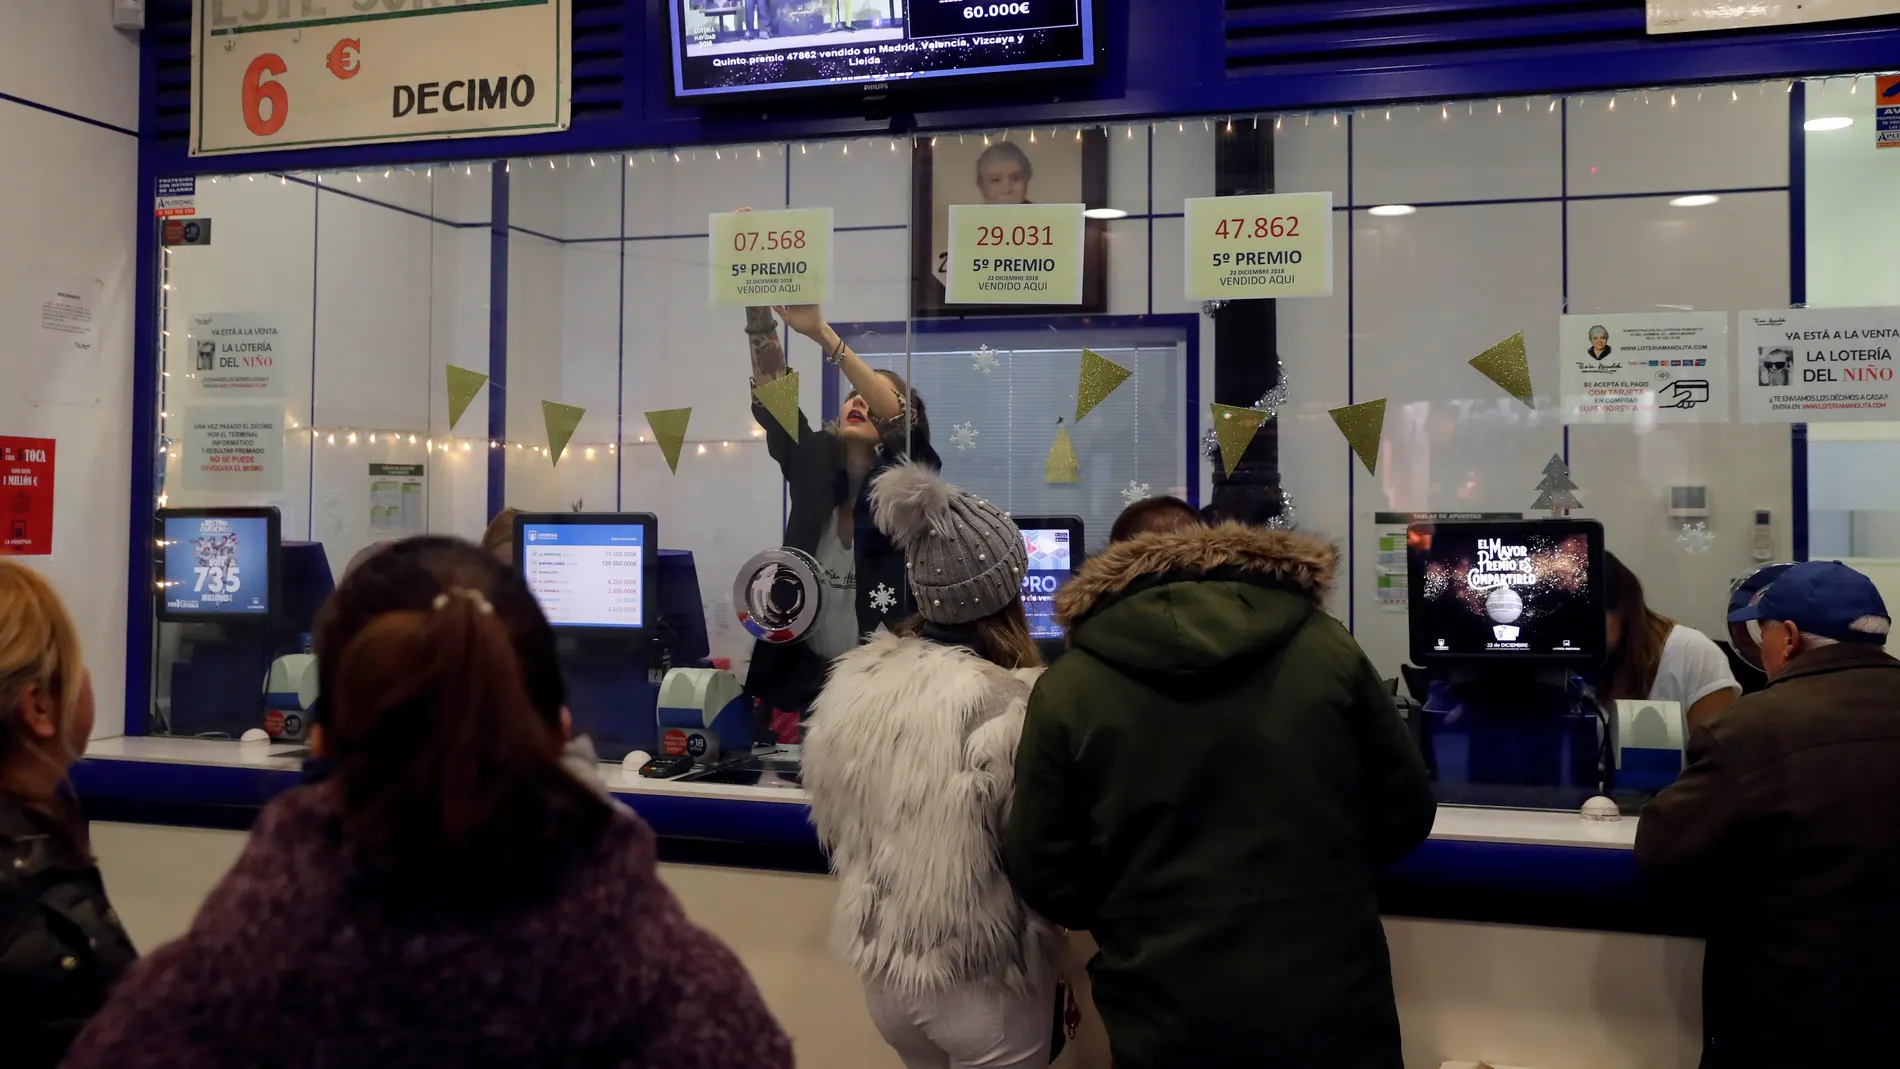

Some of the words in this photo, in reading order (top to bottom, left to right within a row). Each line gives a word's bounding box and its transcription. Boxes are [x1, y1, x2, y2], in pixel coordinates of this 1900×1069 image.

[963, 2, 1030, 19] 60.000€
[713, 58, 747, 67] Quinto
[750, 54, 784, 65] premio
[787, 51, 816, 60] 47862
[819, 48, 860, 58] vendido
[972, 35, 1014, 46] Vizcaya
[1017, 34, 1024, 44] y
[849, 56, 881, 66] Lleida
[242, 53, 288, 136] 6
[326, 38, 360, 80] €
[864, 83, 888, 91] PHILIPS
[393, 74, 535, 118] DECIMO
[1215, 216, 1300, 239] 47.862
[734, 230, 806, 252] 07.568
[976, 225, 1054, 246] 29.031
[972, 259, 989, 272] 5º
[994, 258, 1055, 272] PREMIO
[1212, 253, 1230, 267] 5º
[1236, 250, 1302, 266] PREMIO
[732, 264, 747, 276] 5º
[751, 261, 807, 276] PREMIO
[978, 282, 1021, 291] VENDIDO
[1023, 282, 1048, 291] AQUI
[1220, 276, 1266, 286] VENDIDO
[1268, 275, 1295, 285] AQUI
[737, 285, 777, 294] VENDIDO
[779, 284, 801, 293] AQUI
[221, 327, 236, 336] ESTÁ
[1785, 332, 1800, 340] YA
[1804, 329, 1830, 340] ESTÁ
[1833, 330, 1841, 339] A
[1844, 330, 1859, 339] LA
[1862, 329, 1900, 338] VENTA
[222, 343, 233, 352] LA
[235, 341, 272, 352] LOTERÍA
[220, 357, 239, 368] DEL
[242, 354, 273, 367] NIÑO
[1807, 351, 1825, 362] LA
[1830, 347, 1892, 361] LOTERÍA
[1803, 368, 1837, 382] DEL
[1843, 364, 1893, 382] NIÑO
[1608, 388, 1645, 396] TARJETA
[1830, 393, 1859, 401] DÉCIMOS
[25, 449, 46, 462] TOCA
[8, 474, 32, 486] MILLÓN
[1478, 539, 1489, 549] EL
[1489, 538, 1528, 560] MAYOR
[1477, 550, 1517, 574] PREMIO
[1520, 557, 1533, 573] ES
[1468, 568, 1536, 590] COMPARTIRLO
[689, 738, 704, 747] +18
